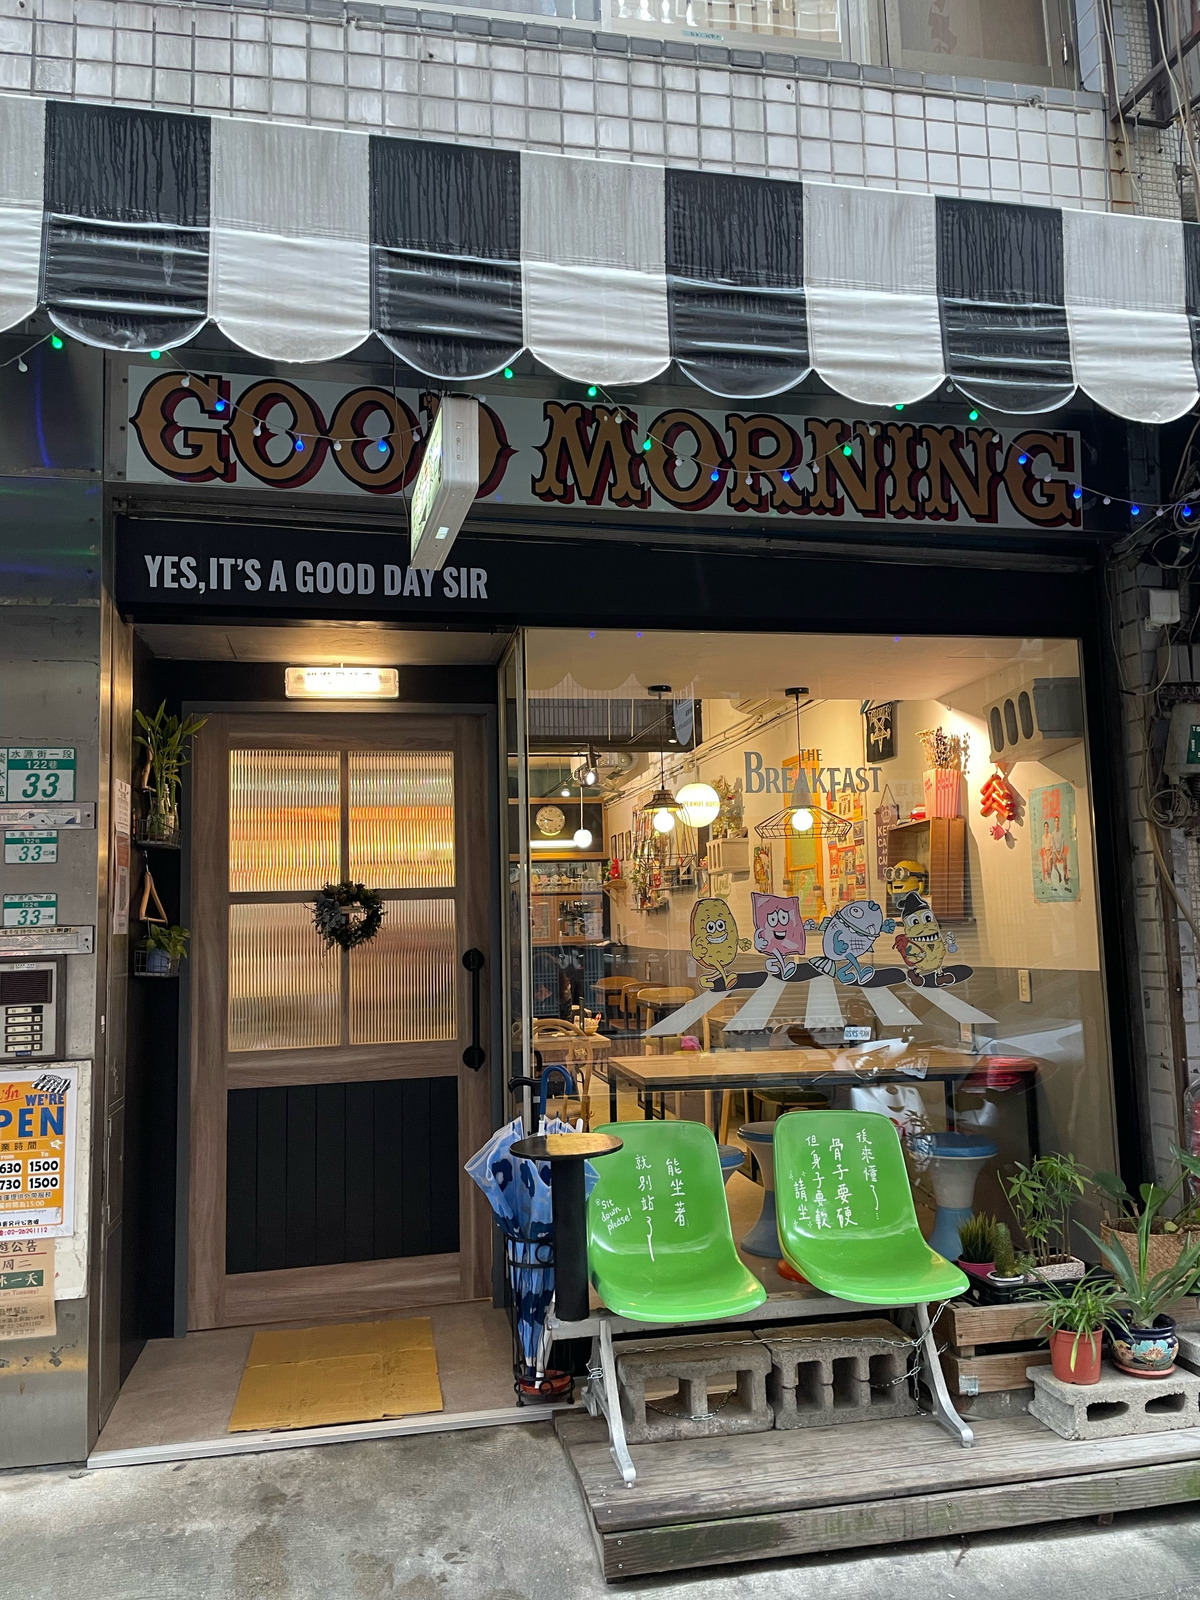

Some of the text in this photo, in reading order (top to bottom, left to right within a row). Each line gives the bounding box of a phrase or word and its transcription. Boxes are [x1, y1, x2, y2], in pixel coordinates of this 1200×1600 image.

[531, 400, 1082, 527] MORNING
[269, 560, 287, 592] A
[296, 561, 374, 595] GOOD
[384, 565, 435, 597] DAY
[443, 567, 488, 599] SIR
[11, 750, 72, 758] 水源街一段
[800, 749, 823, 761] THE
[27, 760, 57, 769] 122巷
[744, 751, 883, 802] BREAKFAST
[22, 773, 60, 798] 33
[19, 845, 42, 861] 33
[18, 909, 41, 926] 33
[25, 1094, 64, 1106] WE'RE
[29, 1161, 58, 1172] 1500
[29, 1177, 58, 1189] 1500
[805, 1134, 832, 1230] 但身子要軟
[829, 1137, 858, 1229] 骨子要硬
[666, 1158, 686, 1227] 能坐著
[794, 1177, 811, 1221] 請坐
[601, 1199, 614, 1210] Sit
[635, 1154, 655, 1262] 就別站了
[601, 1206, 622, 1222] down
[607, 1207, 632, 1236] please!
[2, 1259, 31, 1270] 周二
